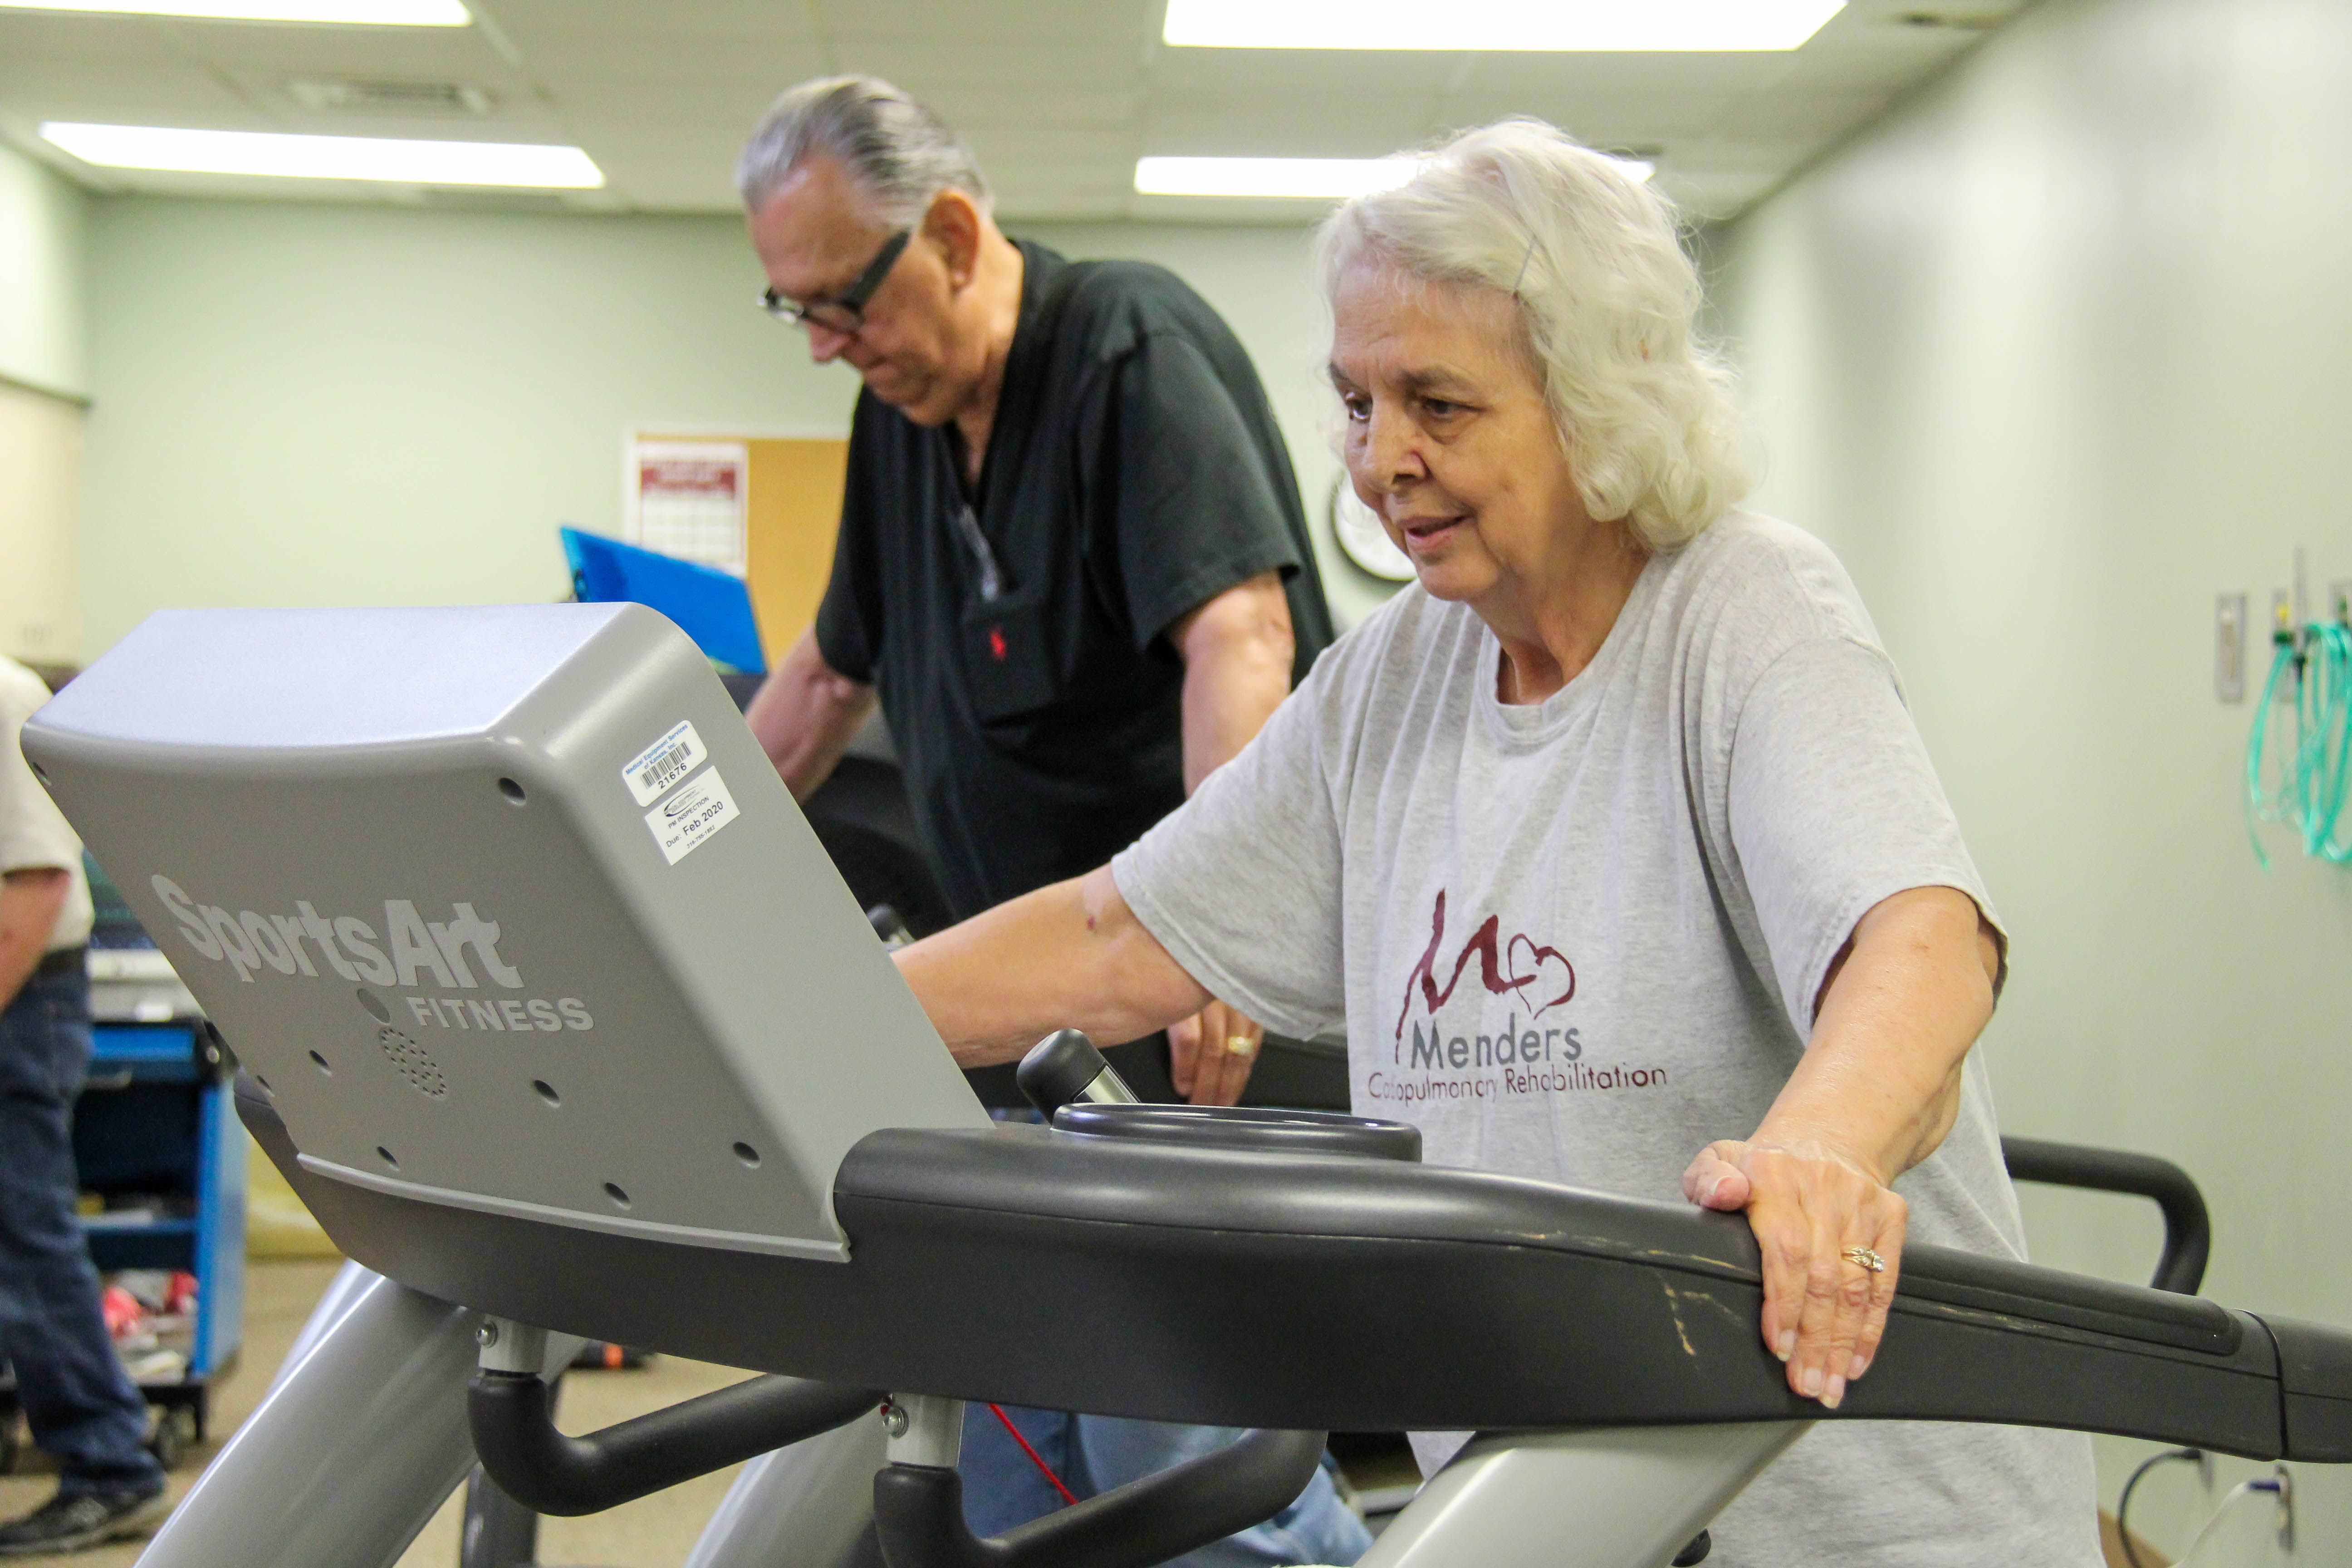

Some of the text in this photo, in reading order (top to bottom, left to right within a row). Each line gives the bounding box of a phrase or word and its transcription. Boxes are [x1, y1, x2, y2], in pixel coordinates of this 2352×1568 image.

[626, 725, 688, 774] Medical Equipment Services
[658, 763, 687, 789] 21676
[666, 834, 682, 848] Due:
[683, 820, 701, 836] Feb
[701, 801, 723, 822] 2020
[668, 820, 678, 829] PM
[677, 796, 710, 822] INSPECTION
[152, 875, 525, 988] SportsArt
[406, 997, 594, 1032] FITNESS
[1411, 1012, 1582, 1069] Menders
[1505, 1063, 1667, 1093] Rehabilitation
